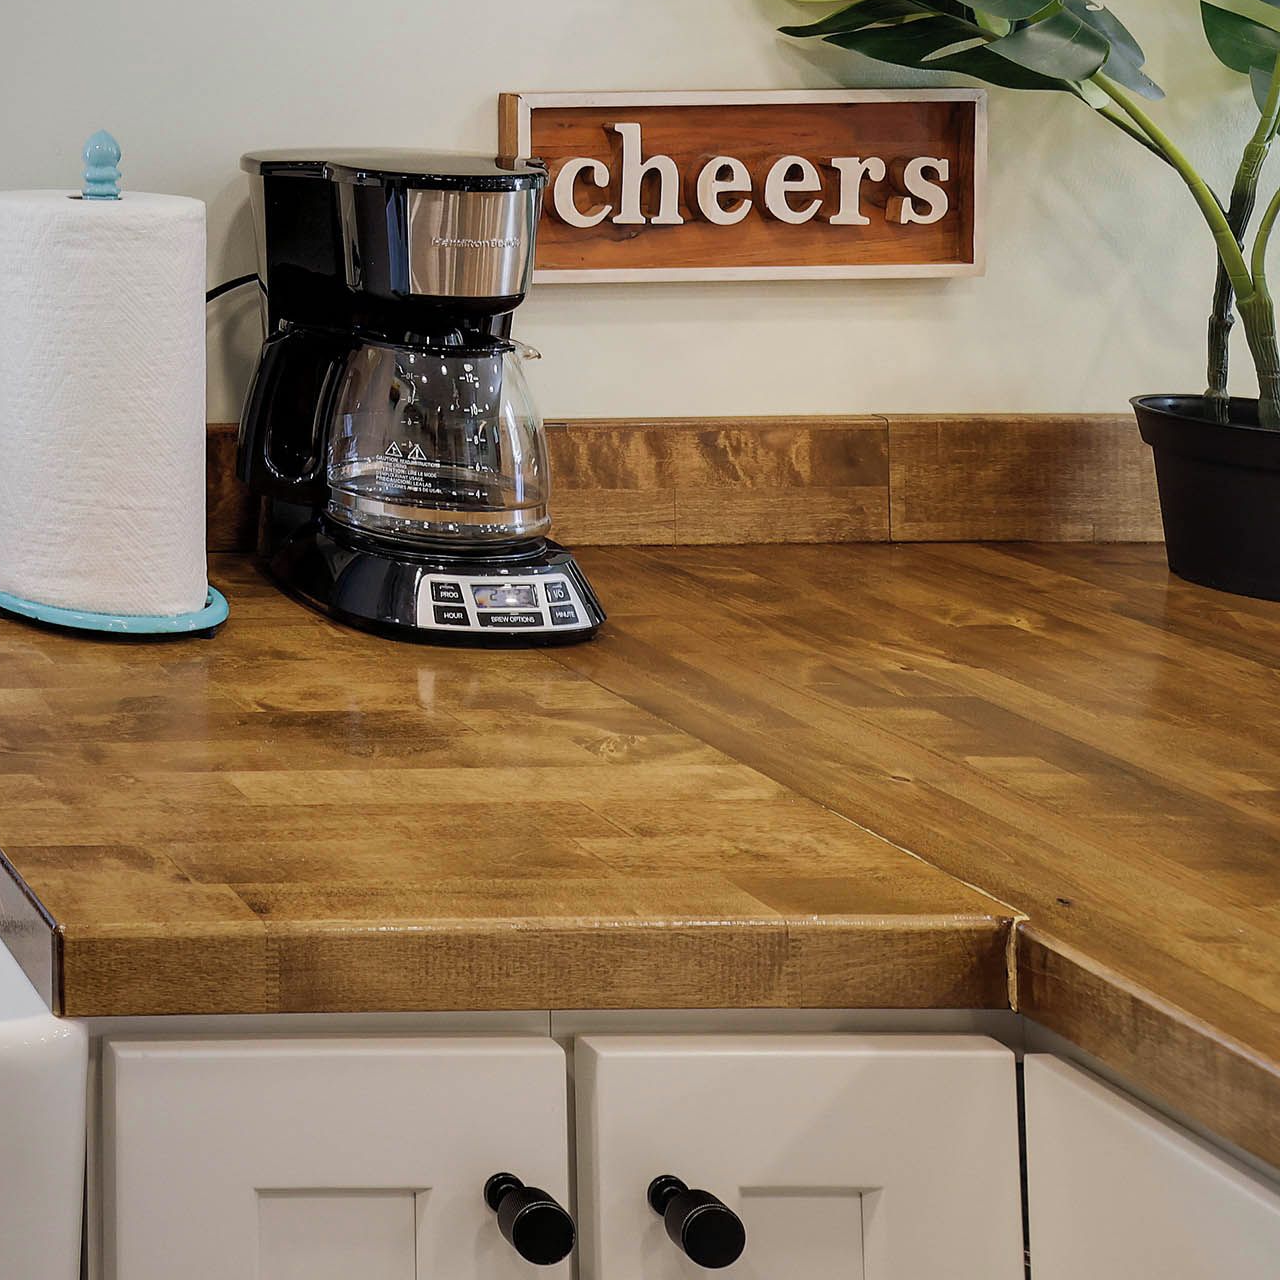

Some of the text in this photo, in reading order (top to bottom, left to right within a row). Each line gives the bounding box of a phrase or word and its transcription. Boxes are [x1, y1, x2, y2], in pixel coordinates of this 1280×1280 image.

[553, 123, 949, 228] cheers
[440, 591, 459, 599] PROG
[443, 612, 464, 620] HOUR
[555, 610, 576, 619] MINUTE
[490, 616, 535, 624] BREW OPTIONS
